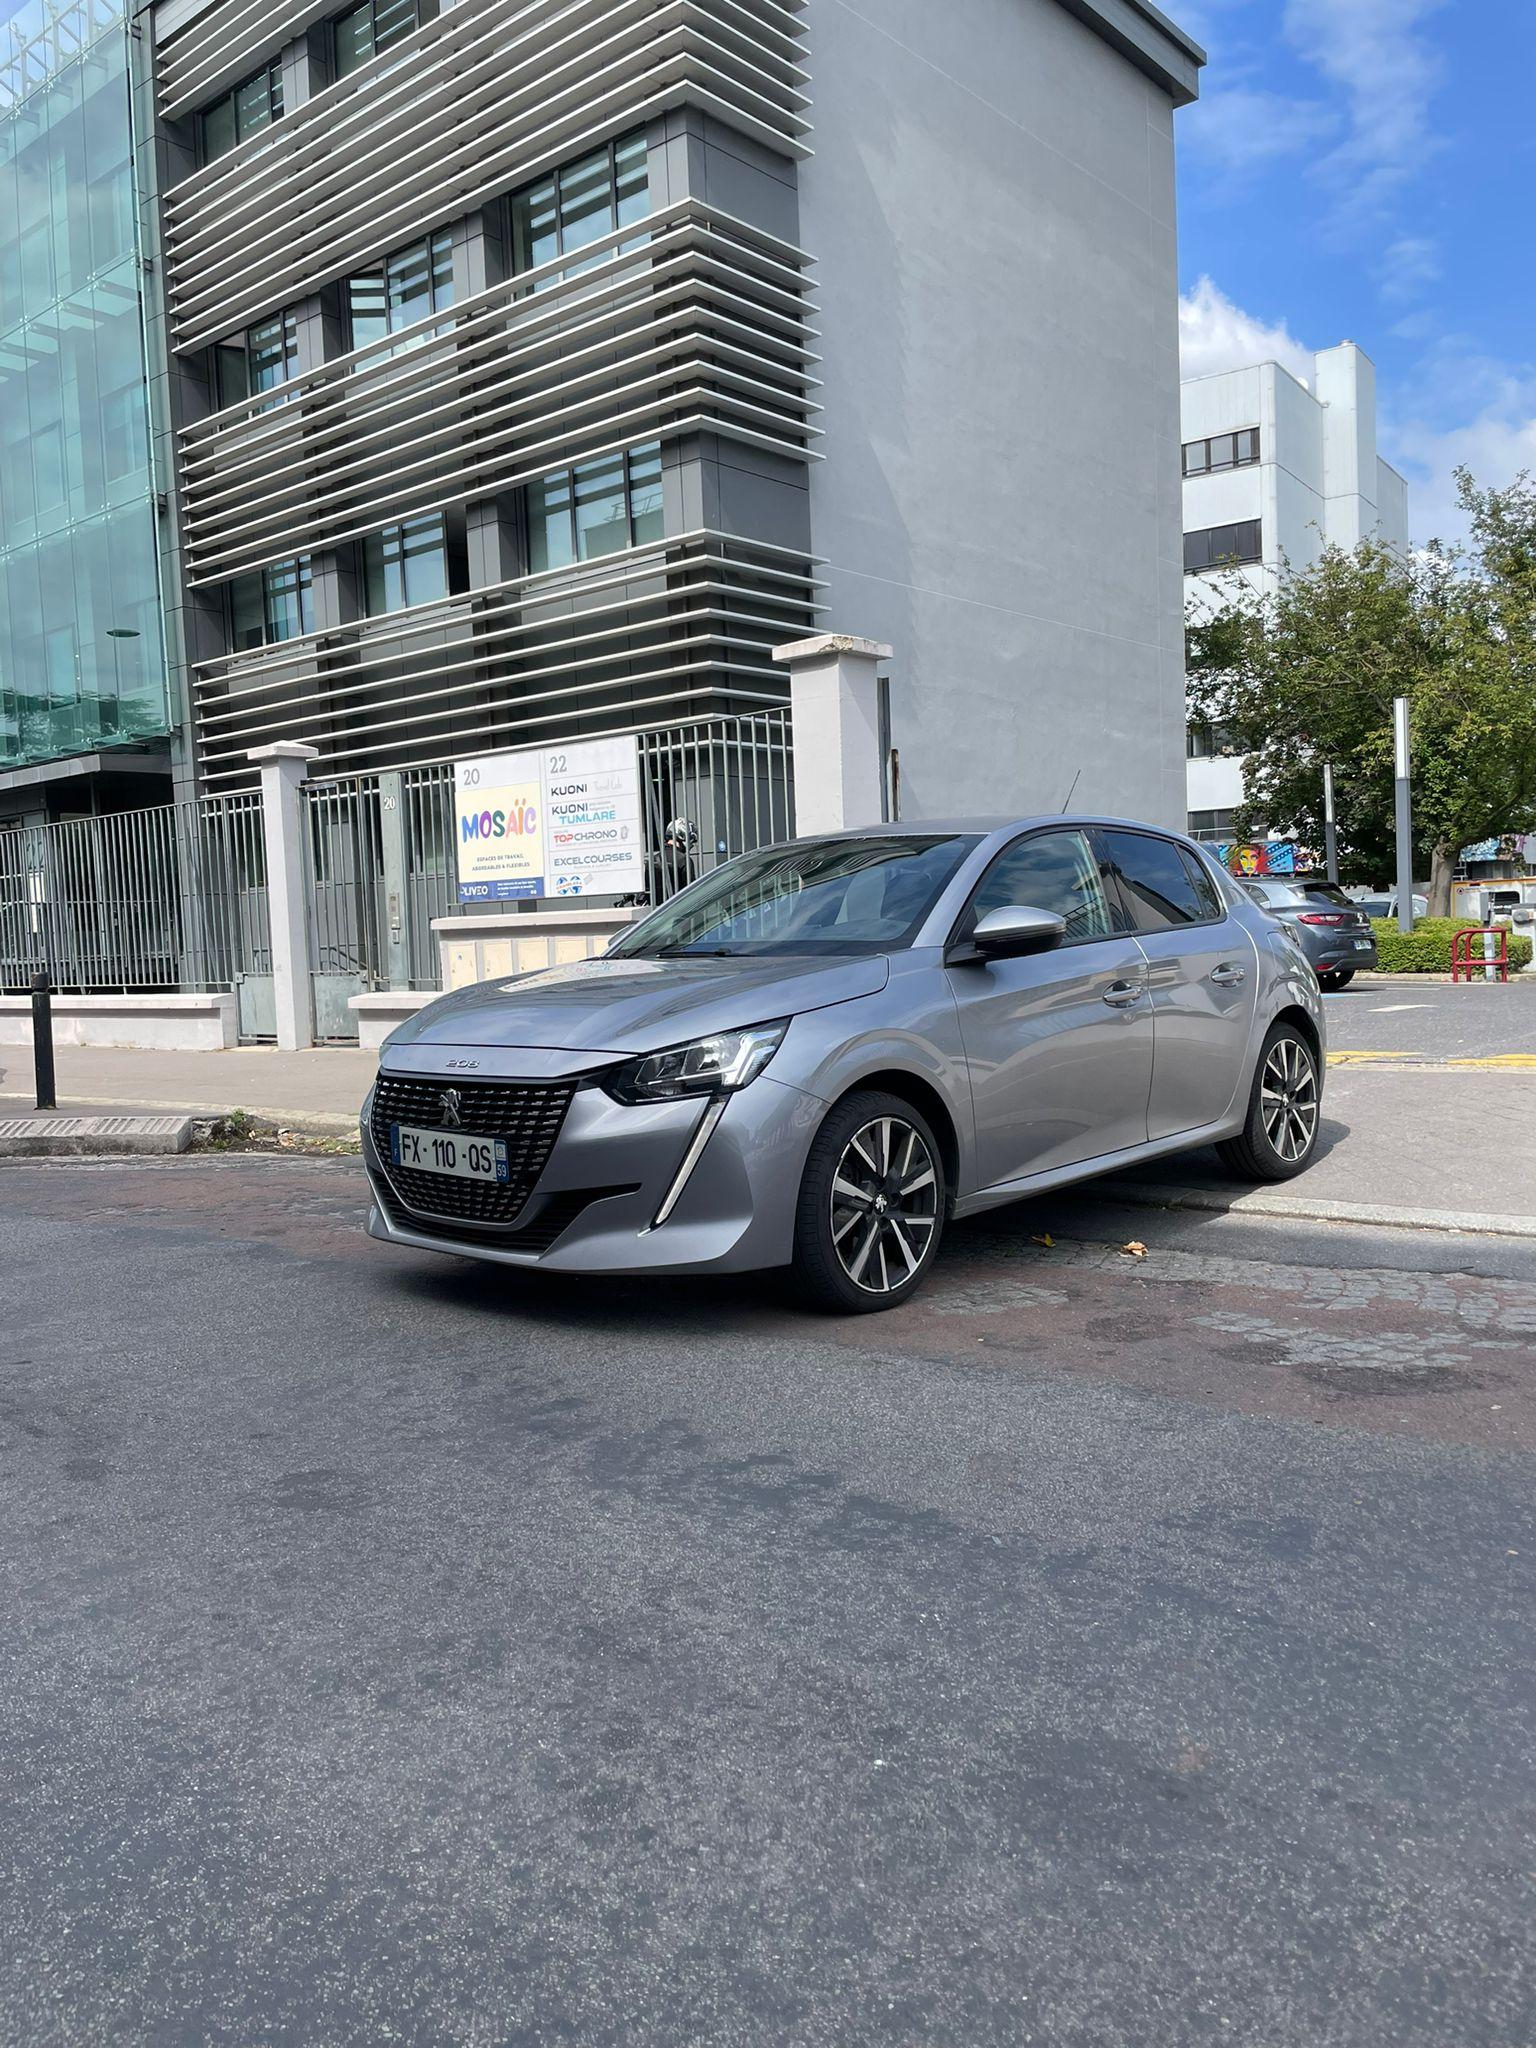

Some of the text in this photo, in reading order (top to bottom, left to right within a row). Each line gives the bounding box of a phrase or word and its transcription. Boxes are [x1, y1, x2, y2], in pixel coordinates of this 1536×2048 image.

[550, 755, 568, 774] 22
[463, 768, 480, 786] 20
[551, 783, 588, 797] KUONI
[384, 796, 396, 810] 20
[552, 803, 589, 816] KUONI
[461, 798, 537, 843] MOSAÏC
[559, 810, 616, 825] TUMLARE
[476, 855, 497, 863] ESPACES
[445, 1059, 480, 1069] 208
[497, 1163, 507, 1178] 59
